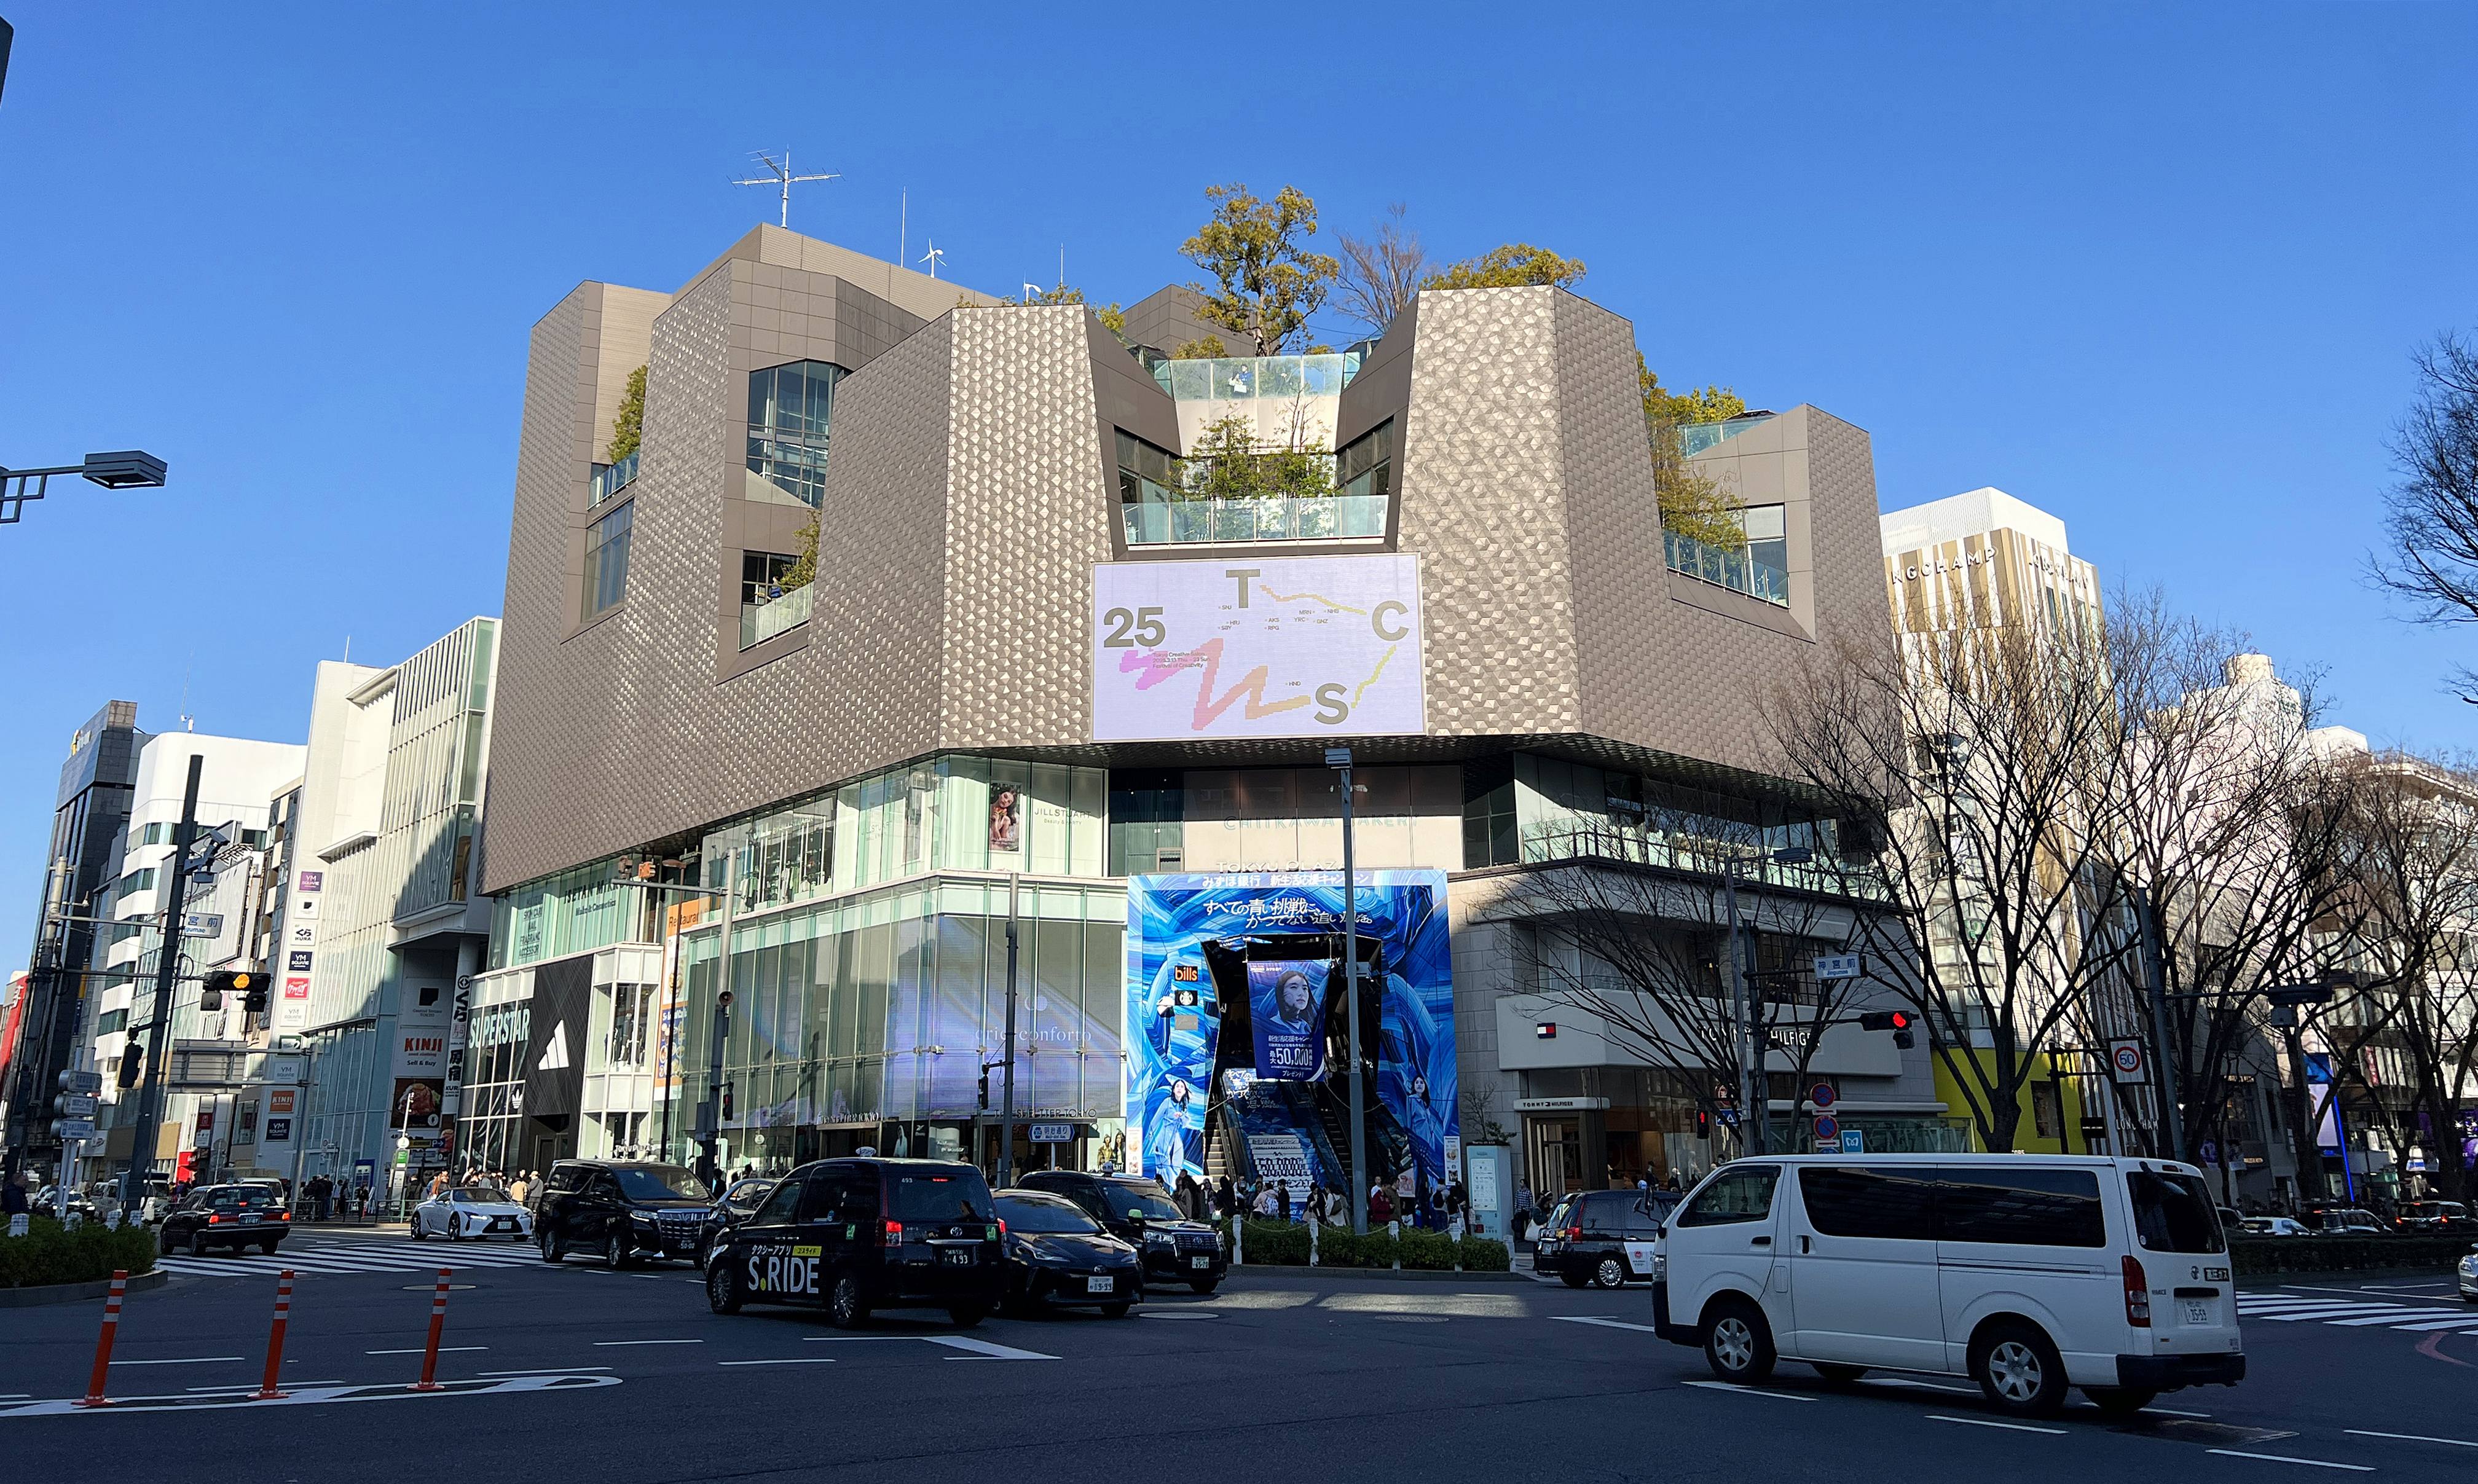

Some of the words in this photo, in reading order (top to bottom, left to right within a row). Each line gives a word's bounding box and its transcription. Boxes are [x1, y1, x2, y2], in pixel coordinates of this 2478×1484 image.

[1888, 546, 1996, 584] NGCHAMP
[1225, 569, 1260, 608] T
[1103, 606, 1166, 648] 25
[1372, 600, 1409, 641] C
[1313, 683, 1348, 724] S
[1034, 807, 1092, 819] JILLSTUART
[1356, 813, 1420, 827] AKERY
[1216, 862, 1278, 873] TOKYU
[1202, 875, 1261, 887] みずほ銀行
[1270, 874, 1369, 887] 新生活応援キャンーン
[564, 883, 594, 905] ISETAN
[1817, 958, 1855, 970] 神宮前
[1175, 967, 1198, 981] bills
[469, 1008, 530, 1048] SUPERSTAR
[1018, 1026, 1092, 1042] conforto
[404, 1037, 443, 1053] KINJI
[1770, 1027, 1820, 1047] HILFIG
[1276, 1048, 1308, 1066] 50,000
[2119, 1054, 2135, 1066] 50
[752, 1244, 792, 1255] タクシーアプリ
[748, 1255, 820, 1294] S.RIDE
